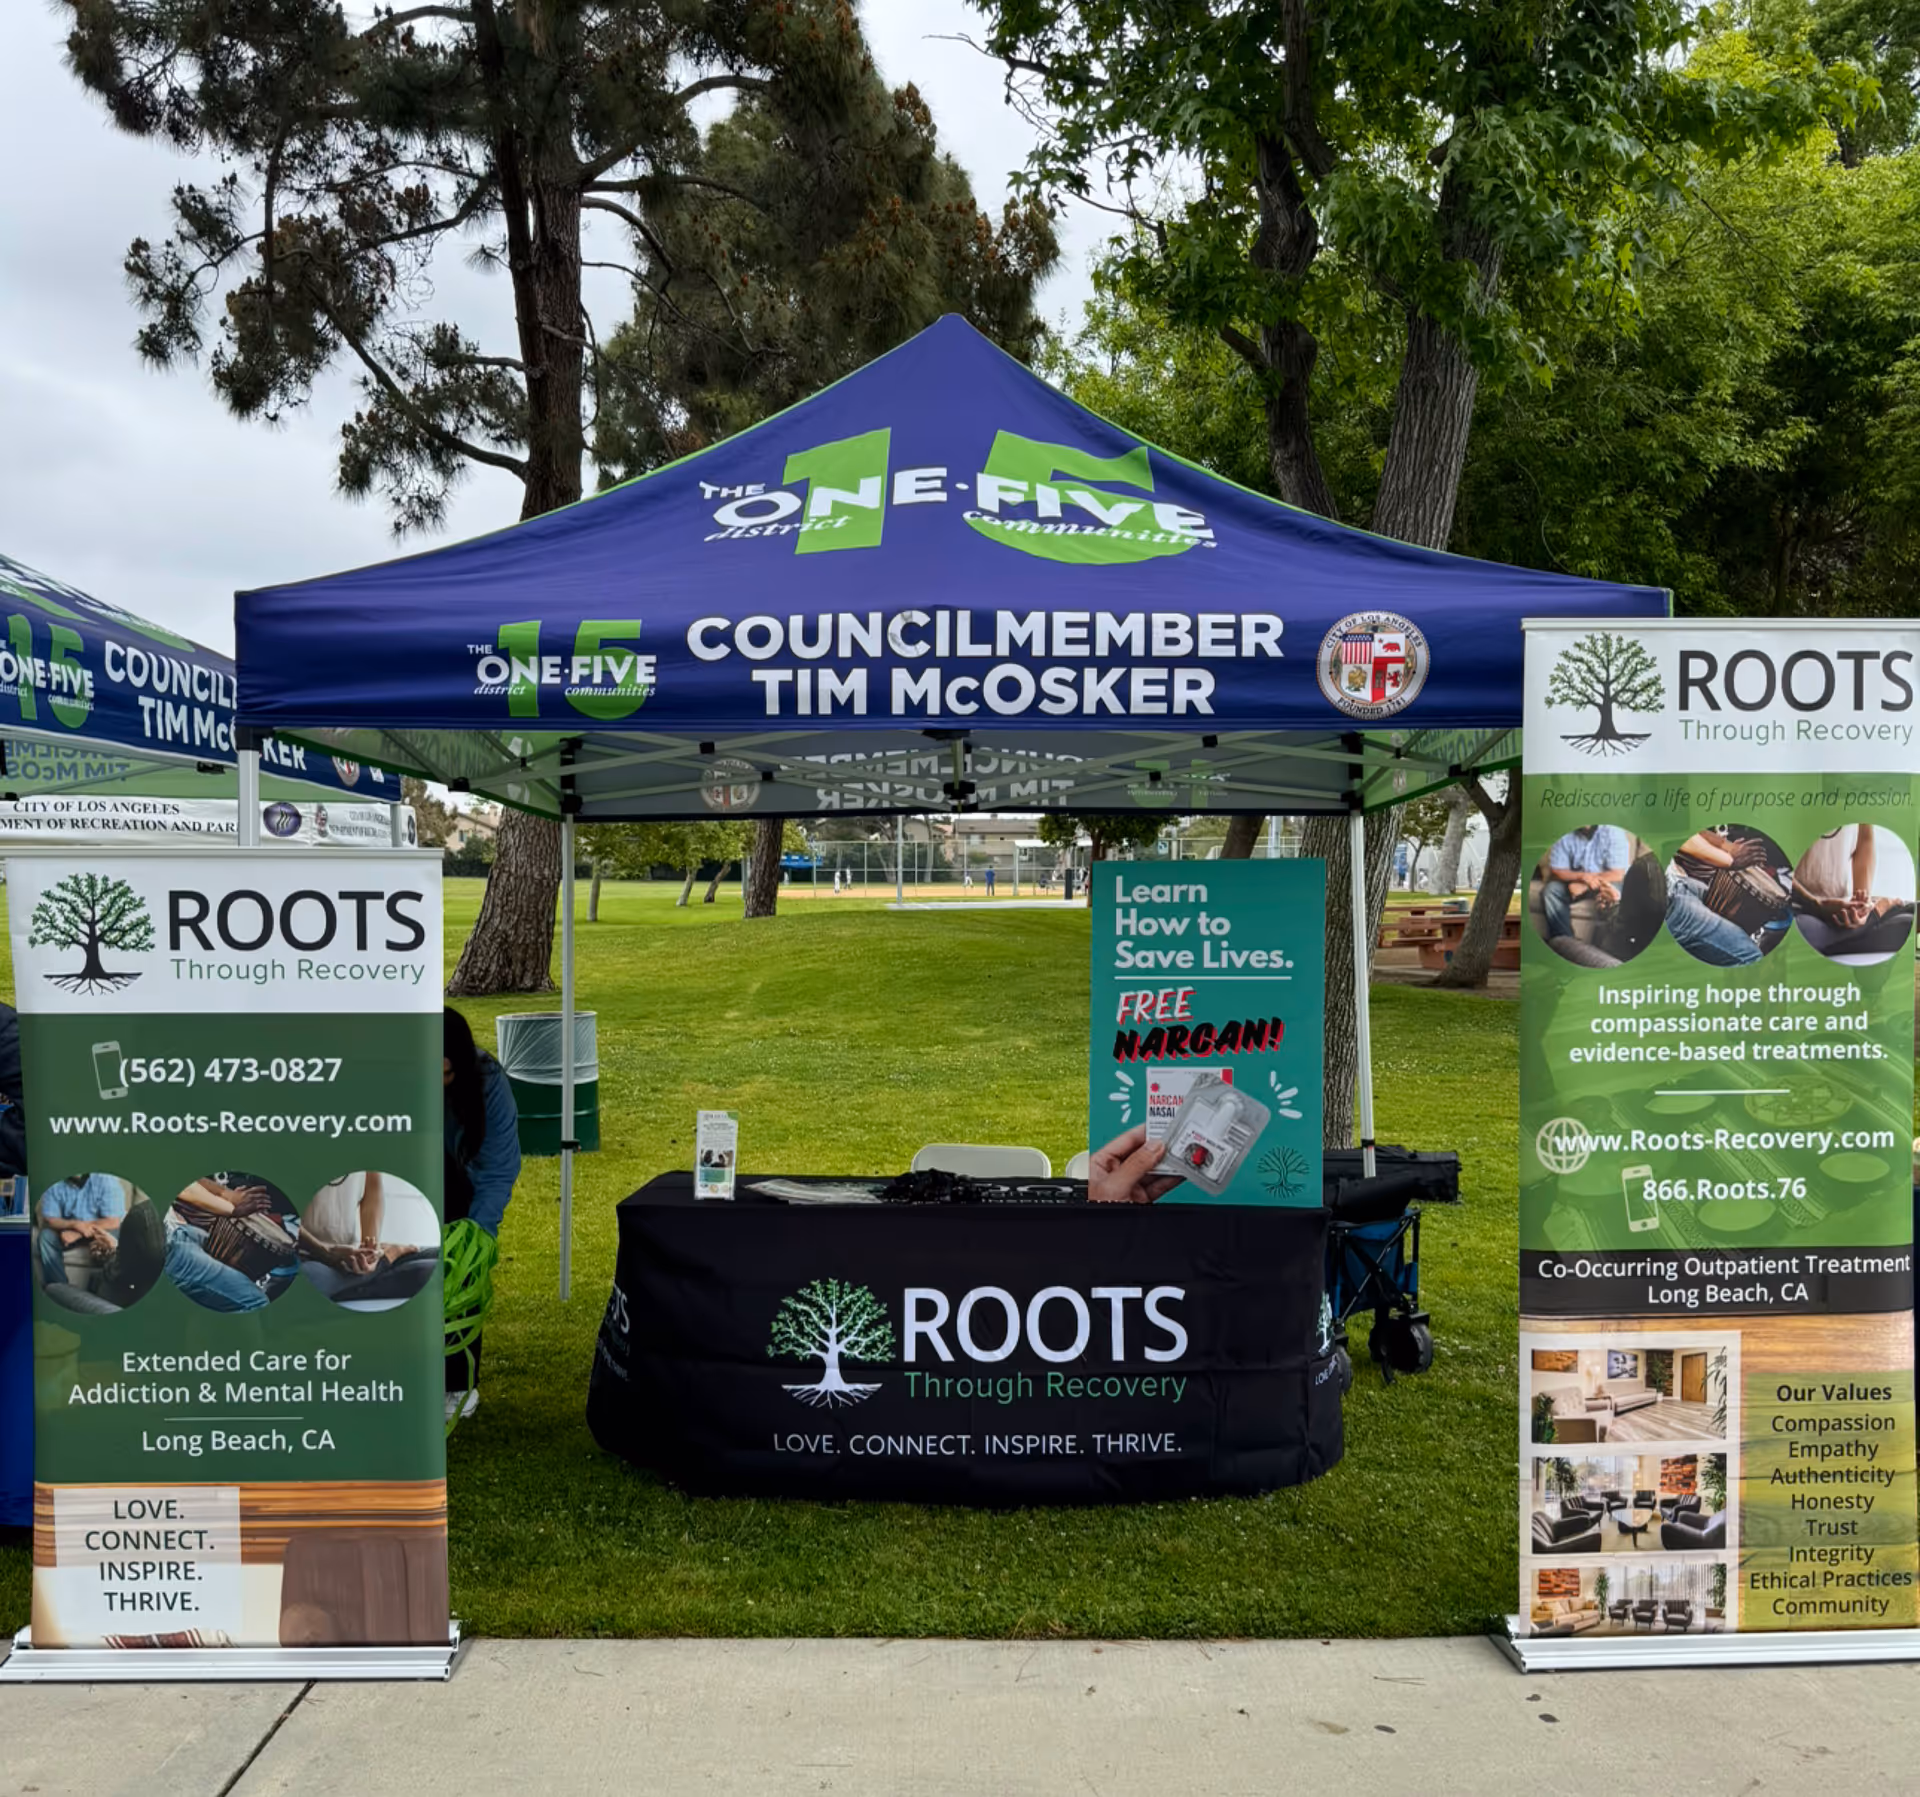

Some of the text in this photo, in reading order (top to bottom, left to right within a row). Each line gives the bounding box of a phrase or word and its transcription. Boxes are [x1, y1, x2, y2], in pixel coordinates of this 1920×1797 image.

[699, 481, 765, 500] THE
[704, 509, 1217, 548] district communities
[686, 609, 1285, 662] COUNCILMEMBER
[1326, 614, 1424, 649] CITY OF LOS ANGELES
[466, 644, 494, 655] THE
[104, 640, 238, 711] COUNCIL
[1679, 648, 1914, 713] ROOTS
[473, 683, 657, 698] district communities
[752, 663, 1217, 717] TIM McOSKER
[1337, 697, 1384, 715] FOUNDED
[138, 696, 189, 744] TIM
[1679, 719, 1914, 746] Through Recovery
[13, 801, 180, 815] CITY OF LOS ANGELES
[1541, 788, 1643, 808] Rediscover
[1645, 792, 1657, 807] a
[1663, 787, 1690, 808] life
[1696, 787, 1718, 810] of
[1719, 792, 1796, 811] purpose
[1801, 787, 1839, 807] and
[0, 818, 239, 833] MENT OF RECREATION AND PAR
[1115, 875, 1208, 904] Learn
[168, 889, 426, 952] ROOTS
[1114, 908, 1231, 937] How to
[1114, 940, 1294, 970] Save Lives.
[170, 958, 426, 986] Through Recovery
[1115, 985, 1198, 1026] FREE
[1598, 982, 1862, 1009] Inspiring hope through
[1590, 1011, 1869, 1038] compassionate care and
[1112, 1016, 1286, 1064] NARCAN!
[1569, 1041, 1889, 1063] evidence-based treatments.
[118, 1057, 343, 1088] (562) 473-0827
[49, 1110, 413, 1138] www.Roots-Recovery.com
[1553, 1129, 1895, 1154] www.Roots-Recovery.com
[1642, 1177, 1808, 1201] 866.Roots.76
[1538, 1253, 1911, 1281] Co-Occurring Outpatient Treatment
[1648, 1282, 1809, 1308] Long Beach, CA
[903, 1286, 1190, 1363] ROOTS
[122, 1349, 352, 1374] Extended Care for
[68, 1379, 404, 1405] Addiction & Mental Health
[905, 1371, 1188, 1405] Through Recovery
[1775, 1383, 1893, 1403] Our Values
[1771, 1413, 1896, 1436] Compassion
[142, 1428, 336, 1456] Long Beach, CA
[773, 1433, 1184, 1456] LOVE. CONNECT. INSPIRE. THRIVE.
[1788, 1439, 1879, 1462] Empathy
[1770, 1465, 1896, 1488] Authenticity
[113, 1499, 186, 1520] LOVE.
[1791, 1493, 1875, 1514] Honesty
[1805, 1518, 1858, 1537] Trust
[85, 1530, 216, 1552] CONNECT.
[1788, 1544, 1875, 1567] Integrity
[99, 1561, 204, 1582] INSPIRE.
[1749, 1569, 1912, 1590] Ethical Practices
[103, 1591, 201, 1612] THRIVE.
[1772, 1596, 1890, 1618] Community
